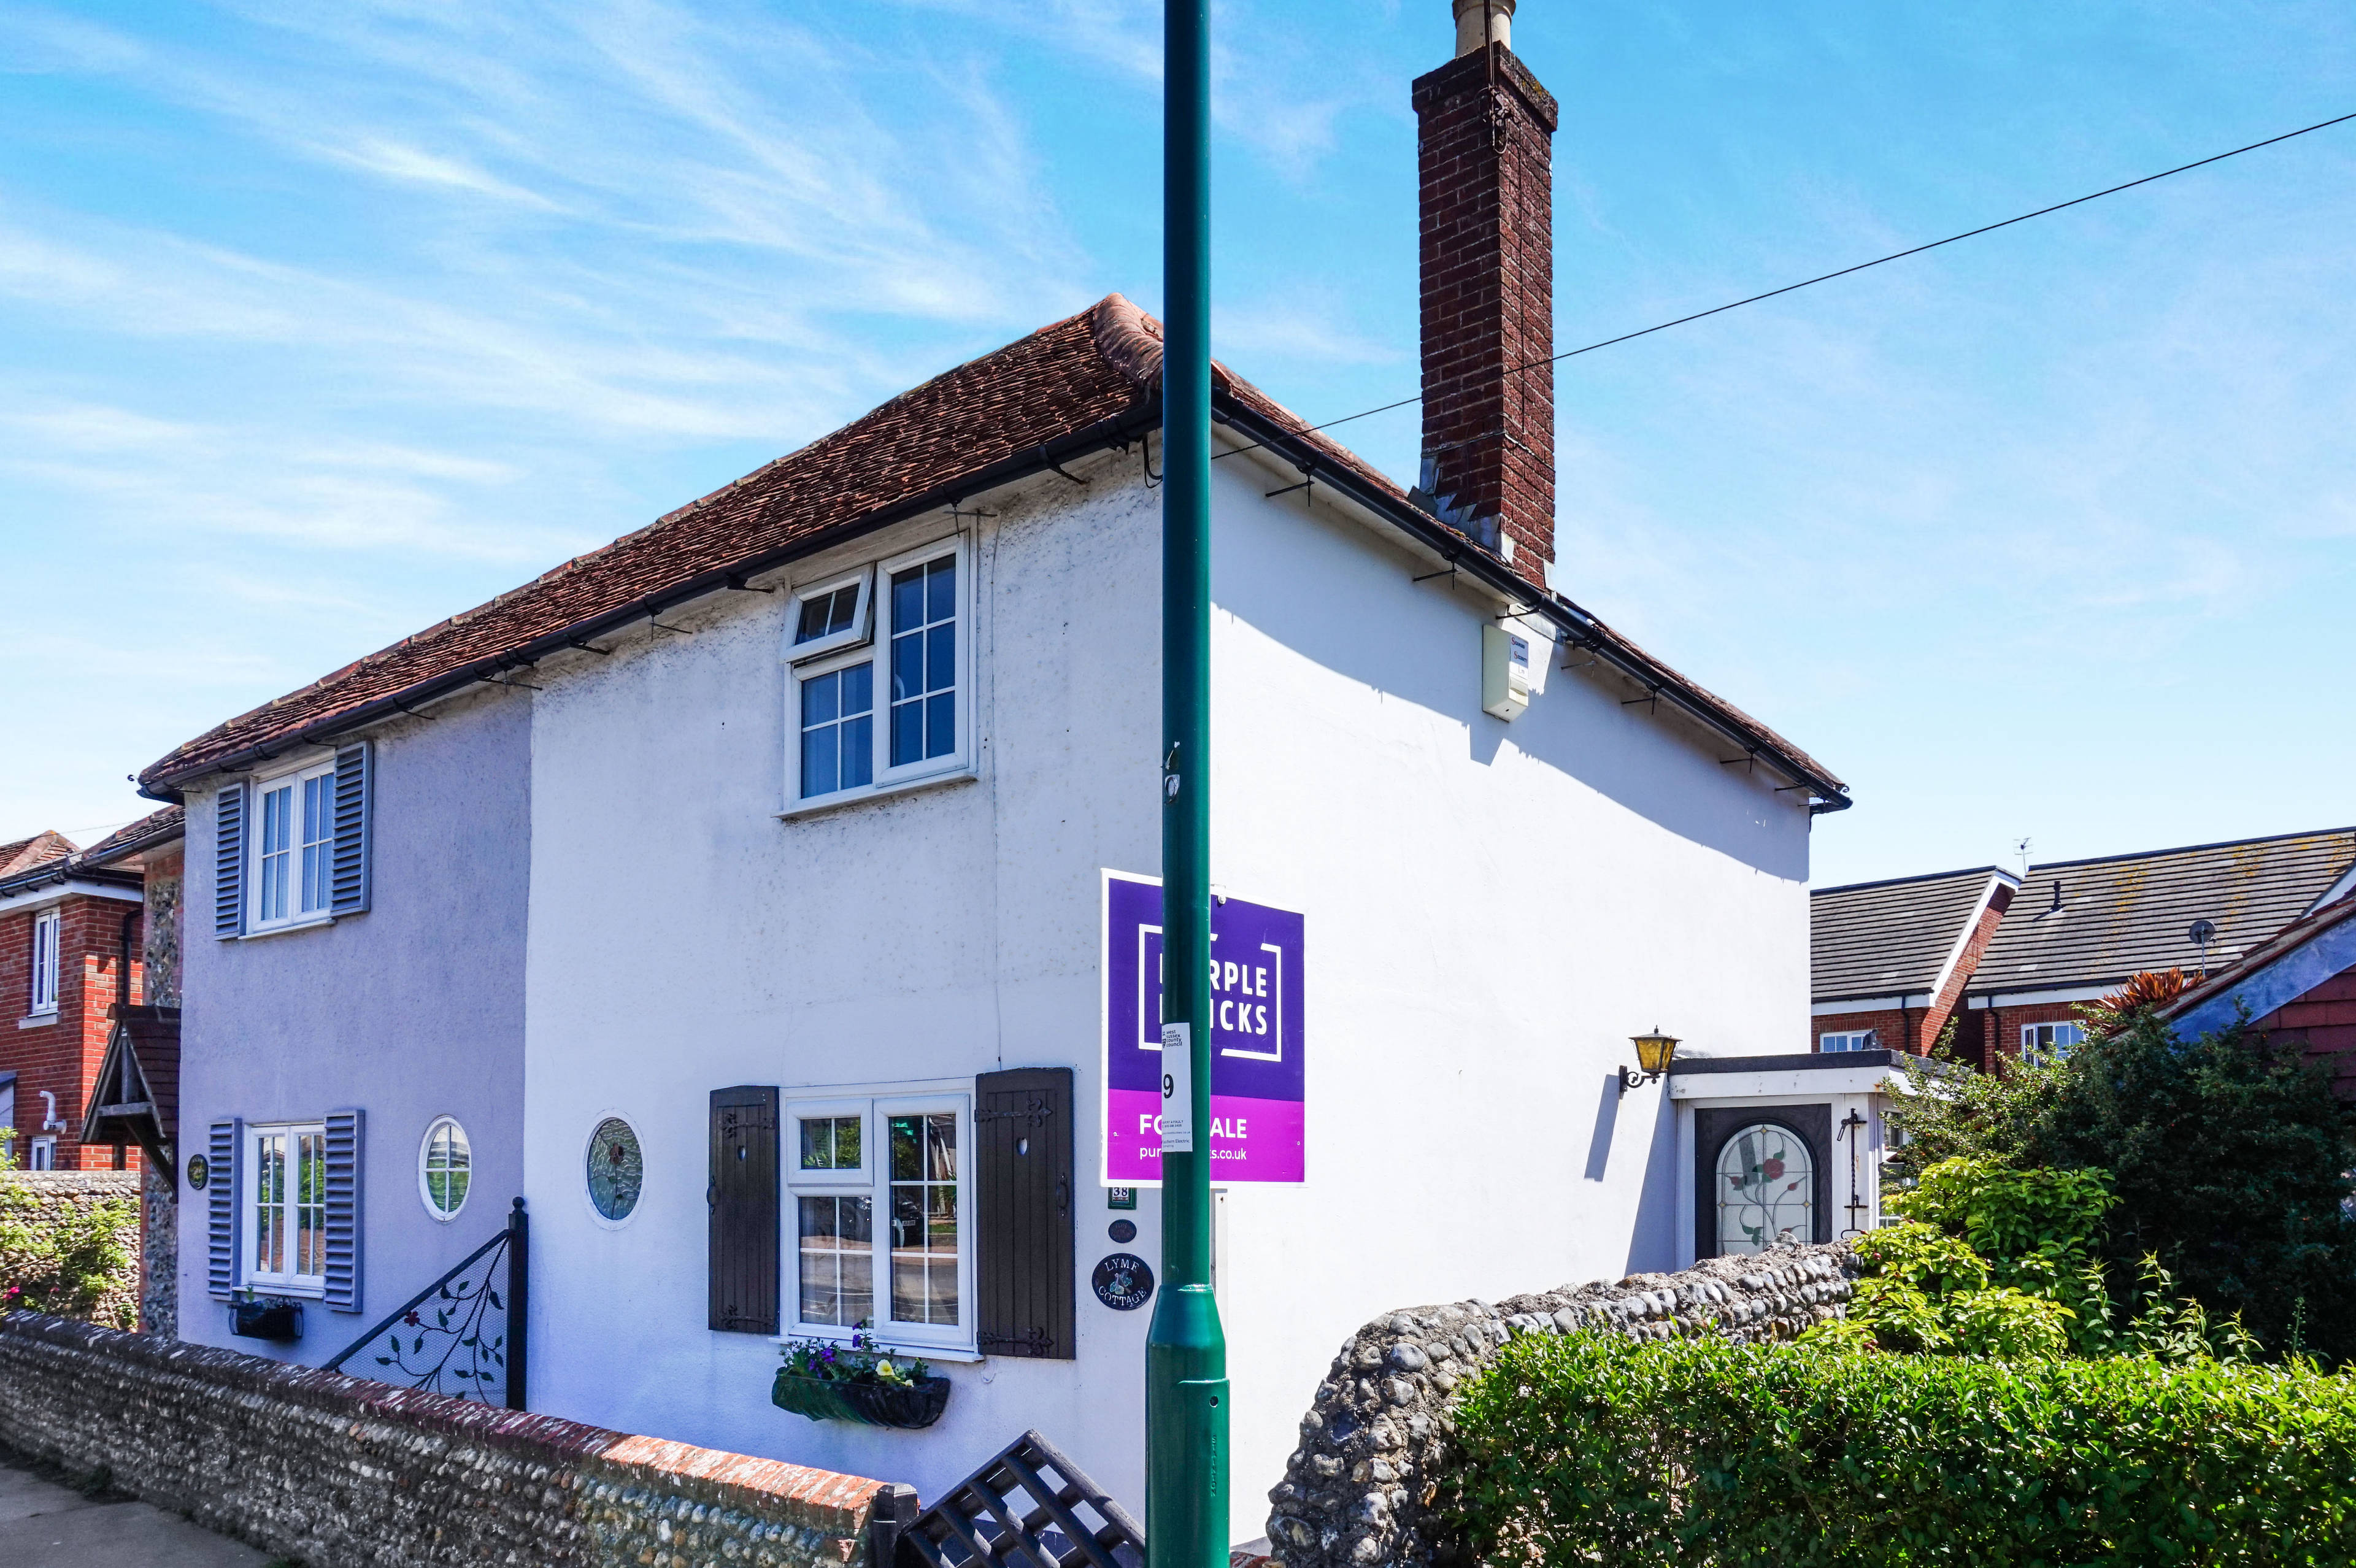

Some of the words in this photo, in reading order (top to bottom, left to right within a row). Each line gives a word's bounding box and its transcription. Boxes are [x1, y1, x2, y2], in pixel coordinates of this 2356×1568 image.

[1163, 1074, 1174, 1099] 9
[1210, 1118, 1247, 1139] ALE
[1114, 1188, 1128, 1196] 38
[1104, 1258, 1140, 1274] LYME
[1099, 1286, 1147, 1307] COTTAGE
